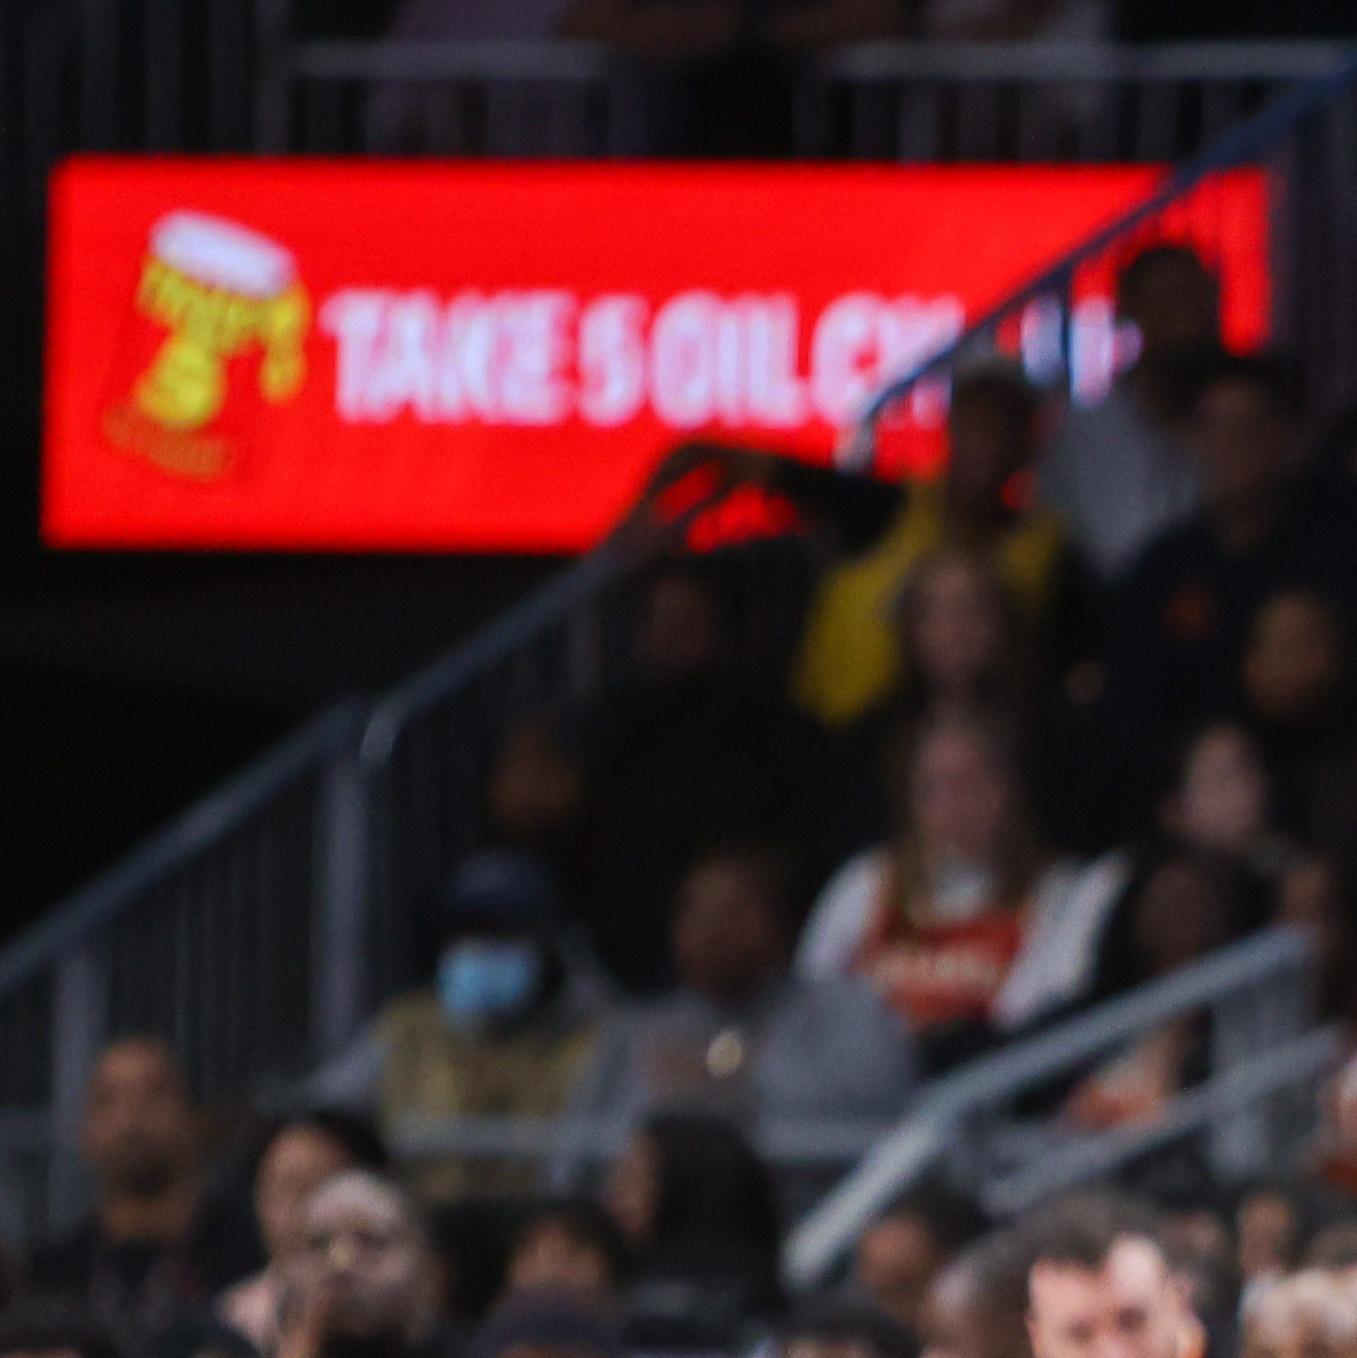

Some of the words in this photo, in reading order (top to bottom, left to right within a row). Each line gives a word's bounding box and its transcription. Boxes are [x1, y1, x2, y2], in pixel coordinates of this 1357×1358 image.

[318, 288, 578, 424] TAKE
[578, 293, 645, 427] 5
[650, 292, 808, 427] OIL
